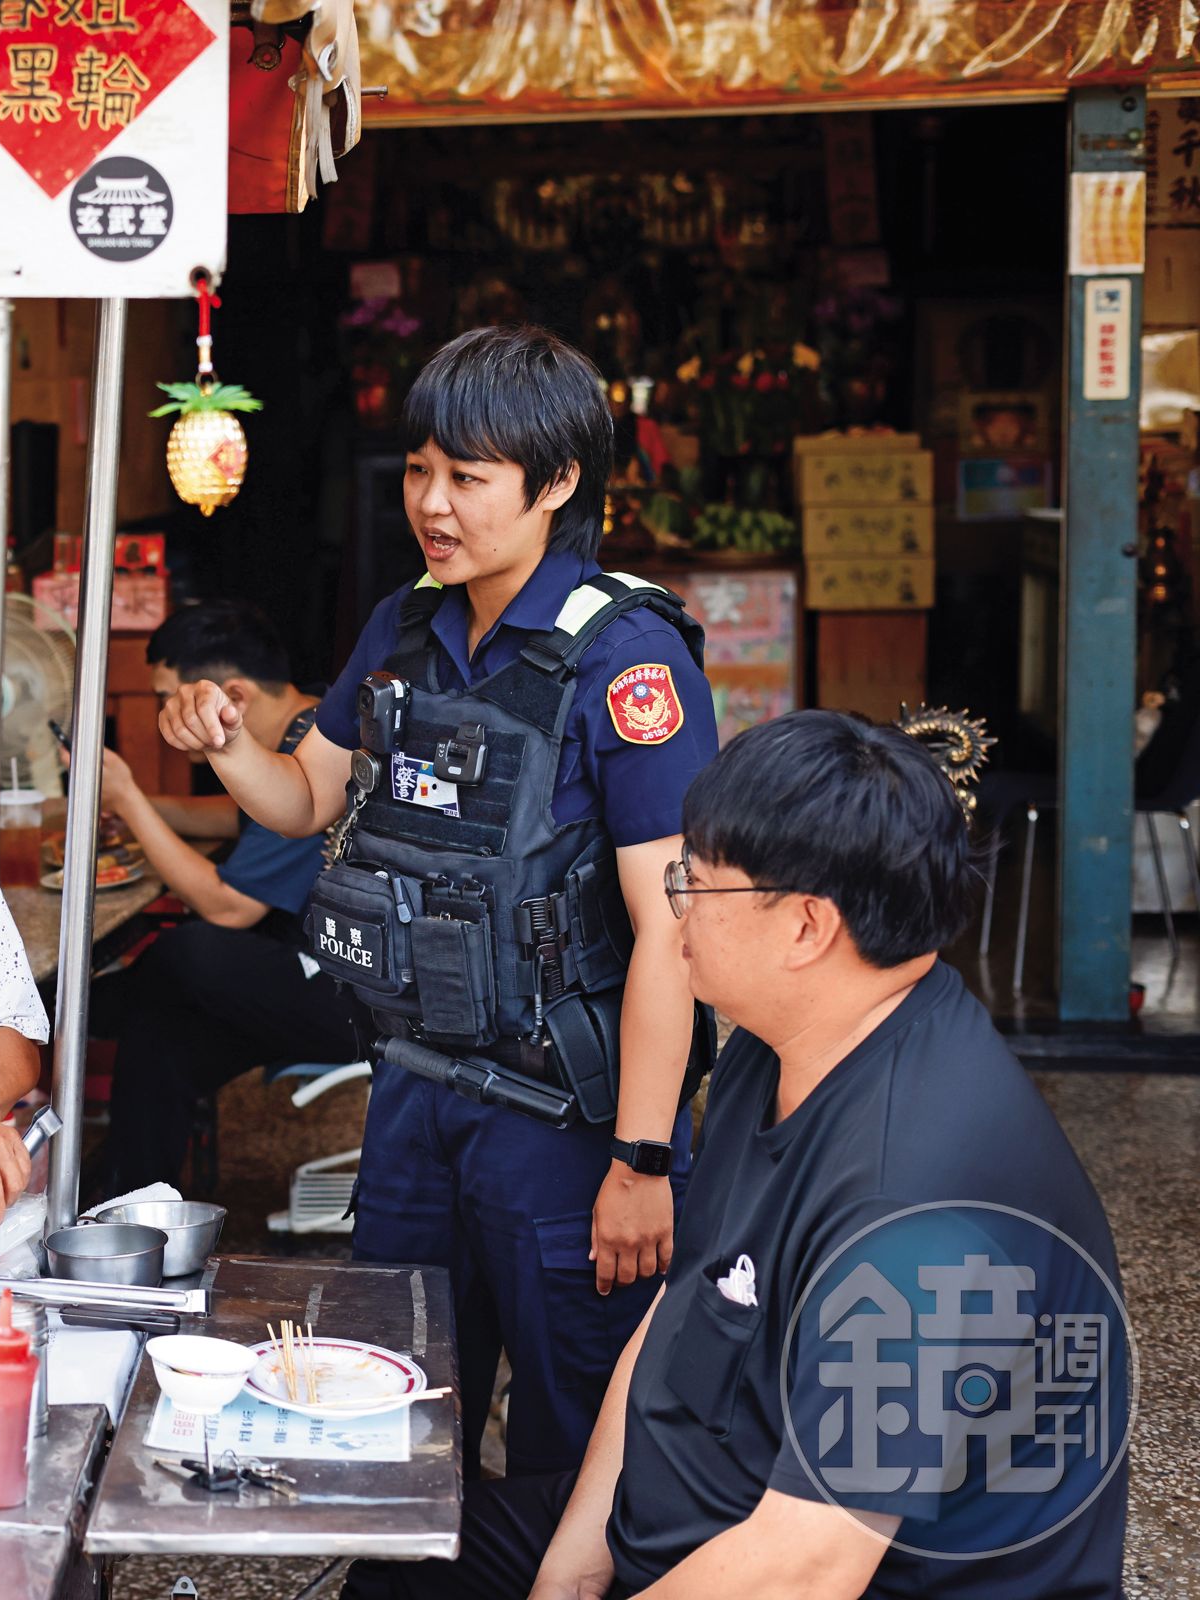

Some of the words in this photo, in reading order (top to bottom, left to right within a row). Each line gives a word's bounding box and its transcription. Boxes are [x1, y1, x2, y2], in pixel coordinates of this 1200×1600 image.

[75, 205, 168, 236] 玄武堂
[394, 765, 417, 799] 警
[325, 916, 363, 947] 警察
[319, 933, 373, 968] POLICE
